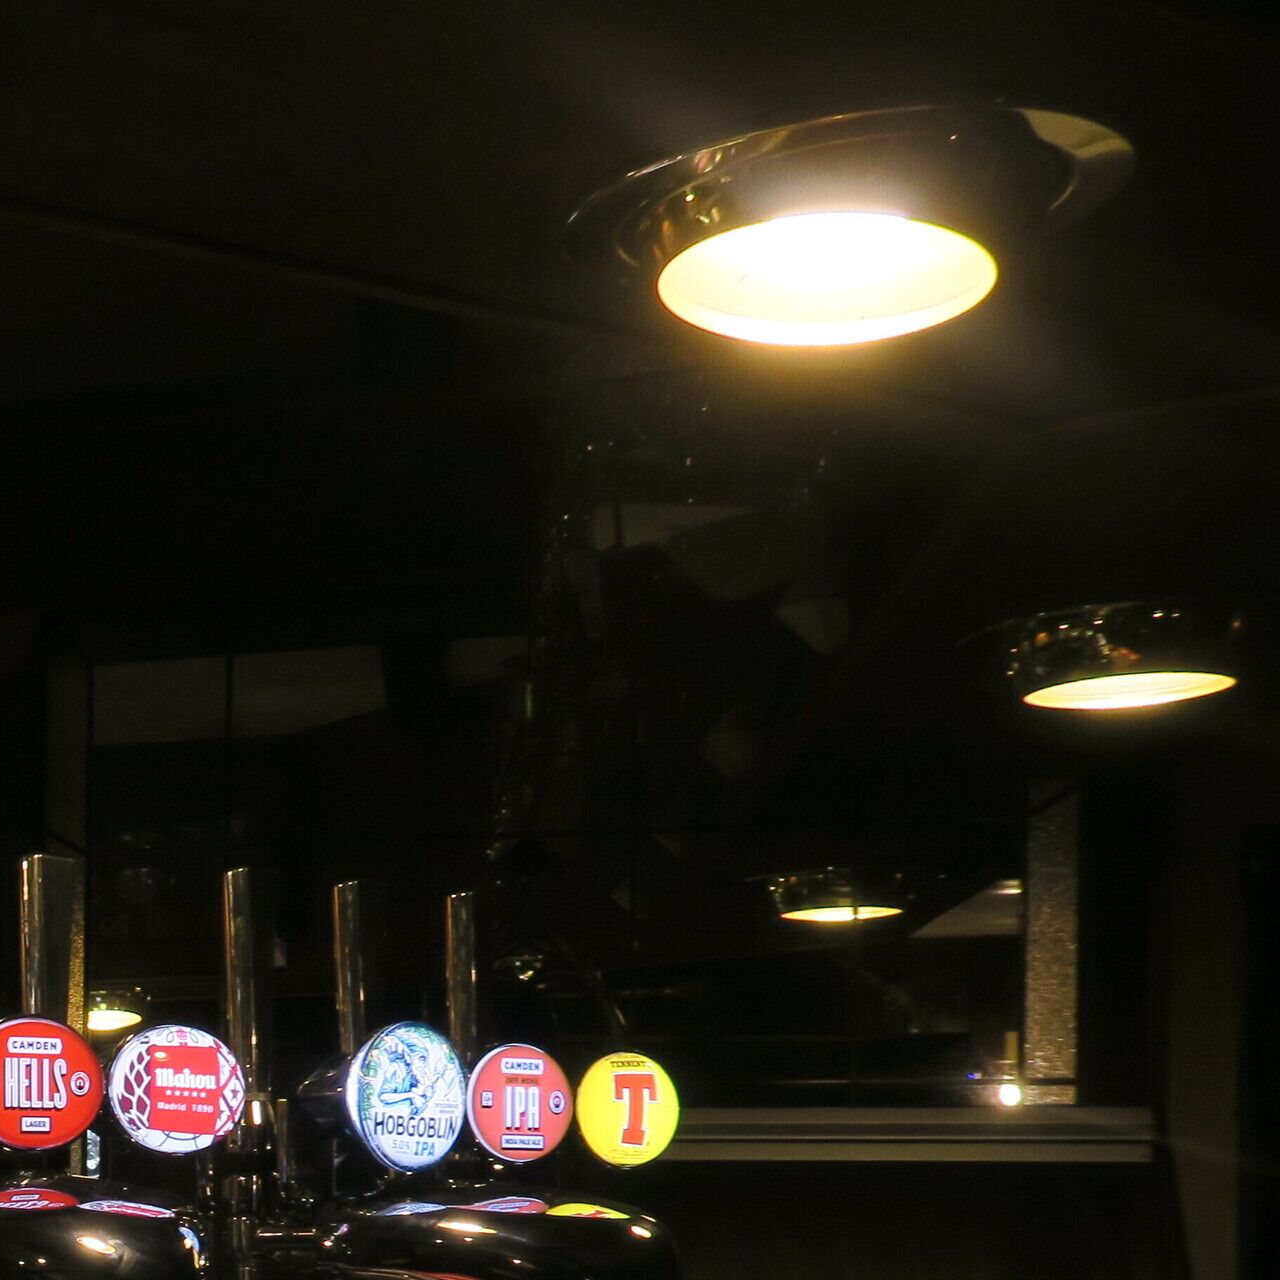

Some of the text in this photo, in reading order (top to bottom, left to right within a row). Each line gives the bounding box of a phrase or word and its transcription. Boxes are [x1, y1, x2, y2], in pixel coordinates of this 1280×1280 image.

[11, 1040, 58, 1050] CAMDEN
[503, 1061, 540, 1071] CAMDEN
[4, 1057, 68, 1110] HELLS
[154, 1067, 217, 1090] Mahou
[156, 1101, 187, 1111] Madrid
[505, 1085, 541, 1130] IPA
[612, 1072, 659, 1147] T
[24, 1120, 47, 1128] LAGER
[373, 1111, 459, 1140] HOBGOBLIN
[414, 1140, 435, 1157] IPA
